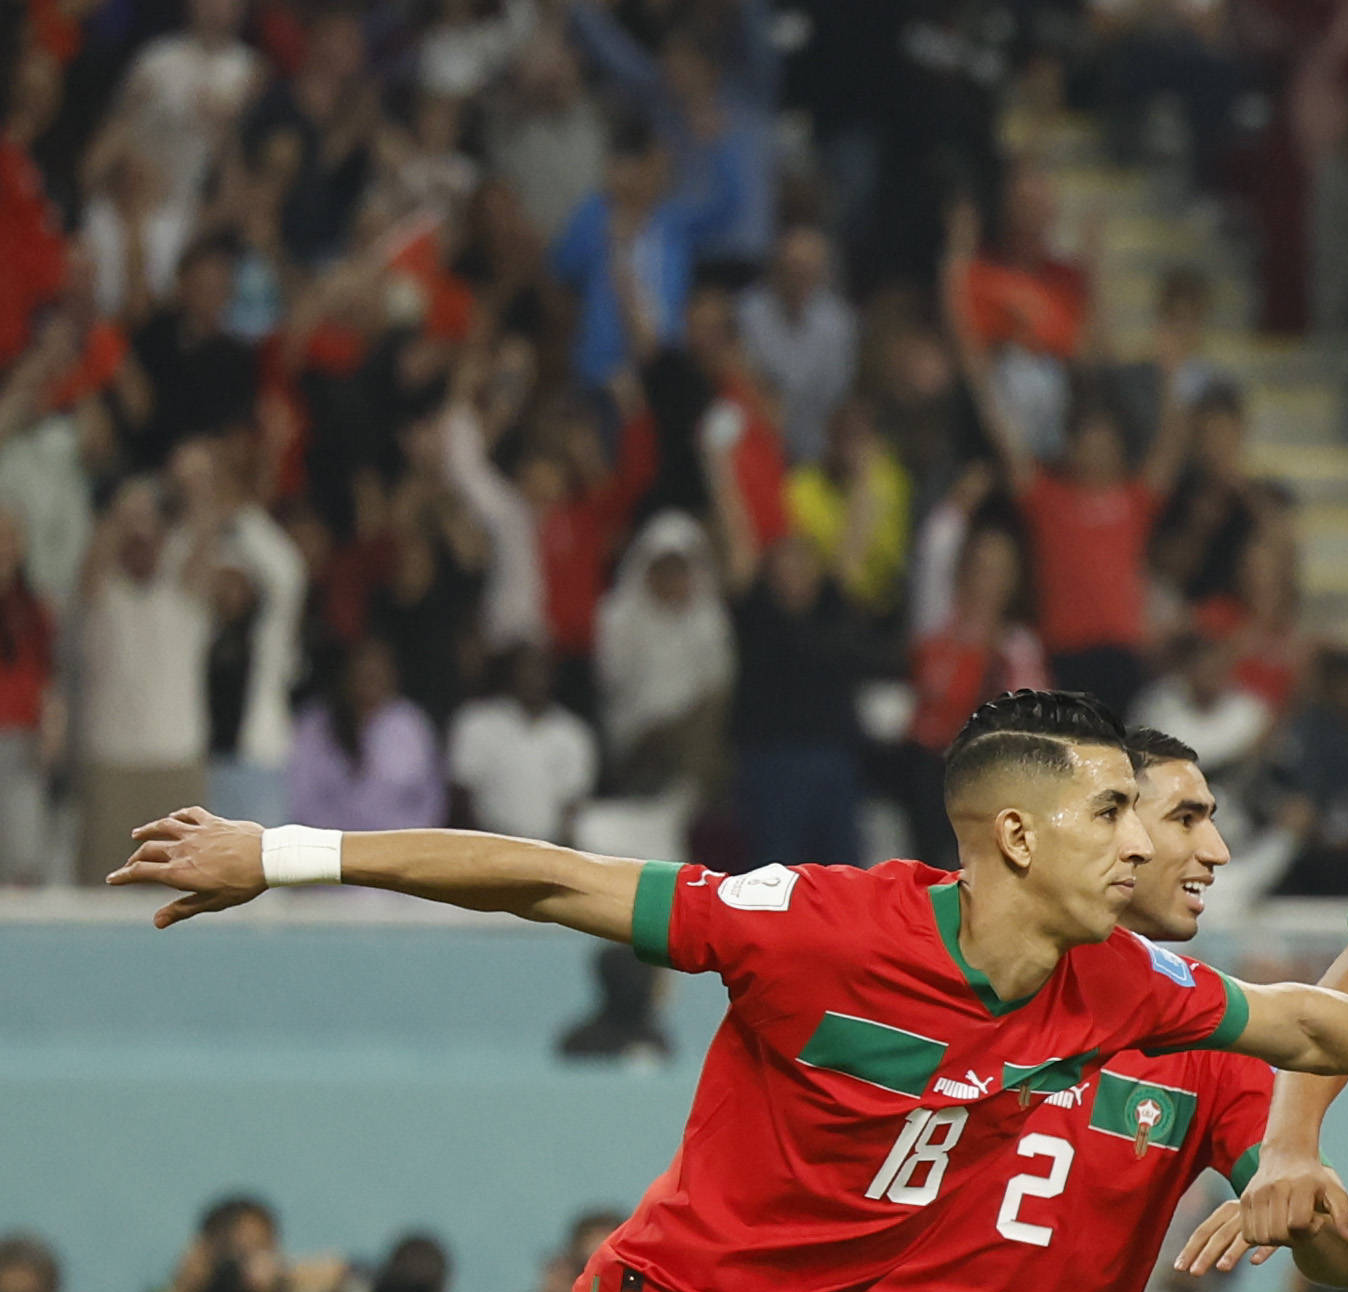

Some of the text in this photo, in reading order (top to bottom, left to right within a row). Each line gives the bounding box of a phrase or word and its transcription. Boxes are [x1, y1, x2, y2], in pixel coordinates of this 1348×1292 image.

[933, 1077, 980, 1100] PUMA
[865, 1106, 969, 1207] 18
[996, 1133, 1075, 1248] 2
